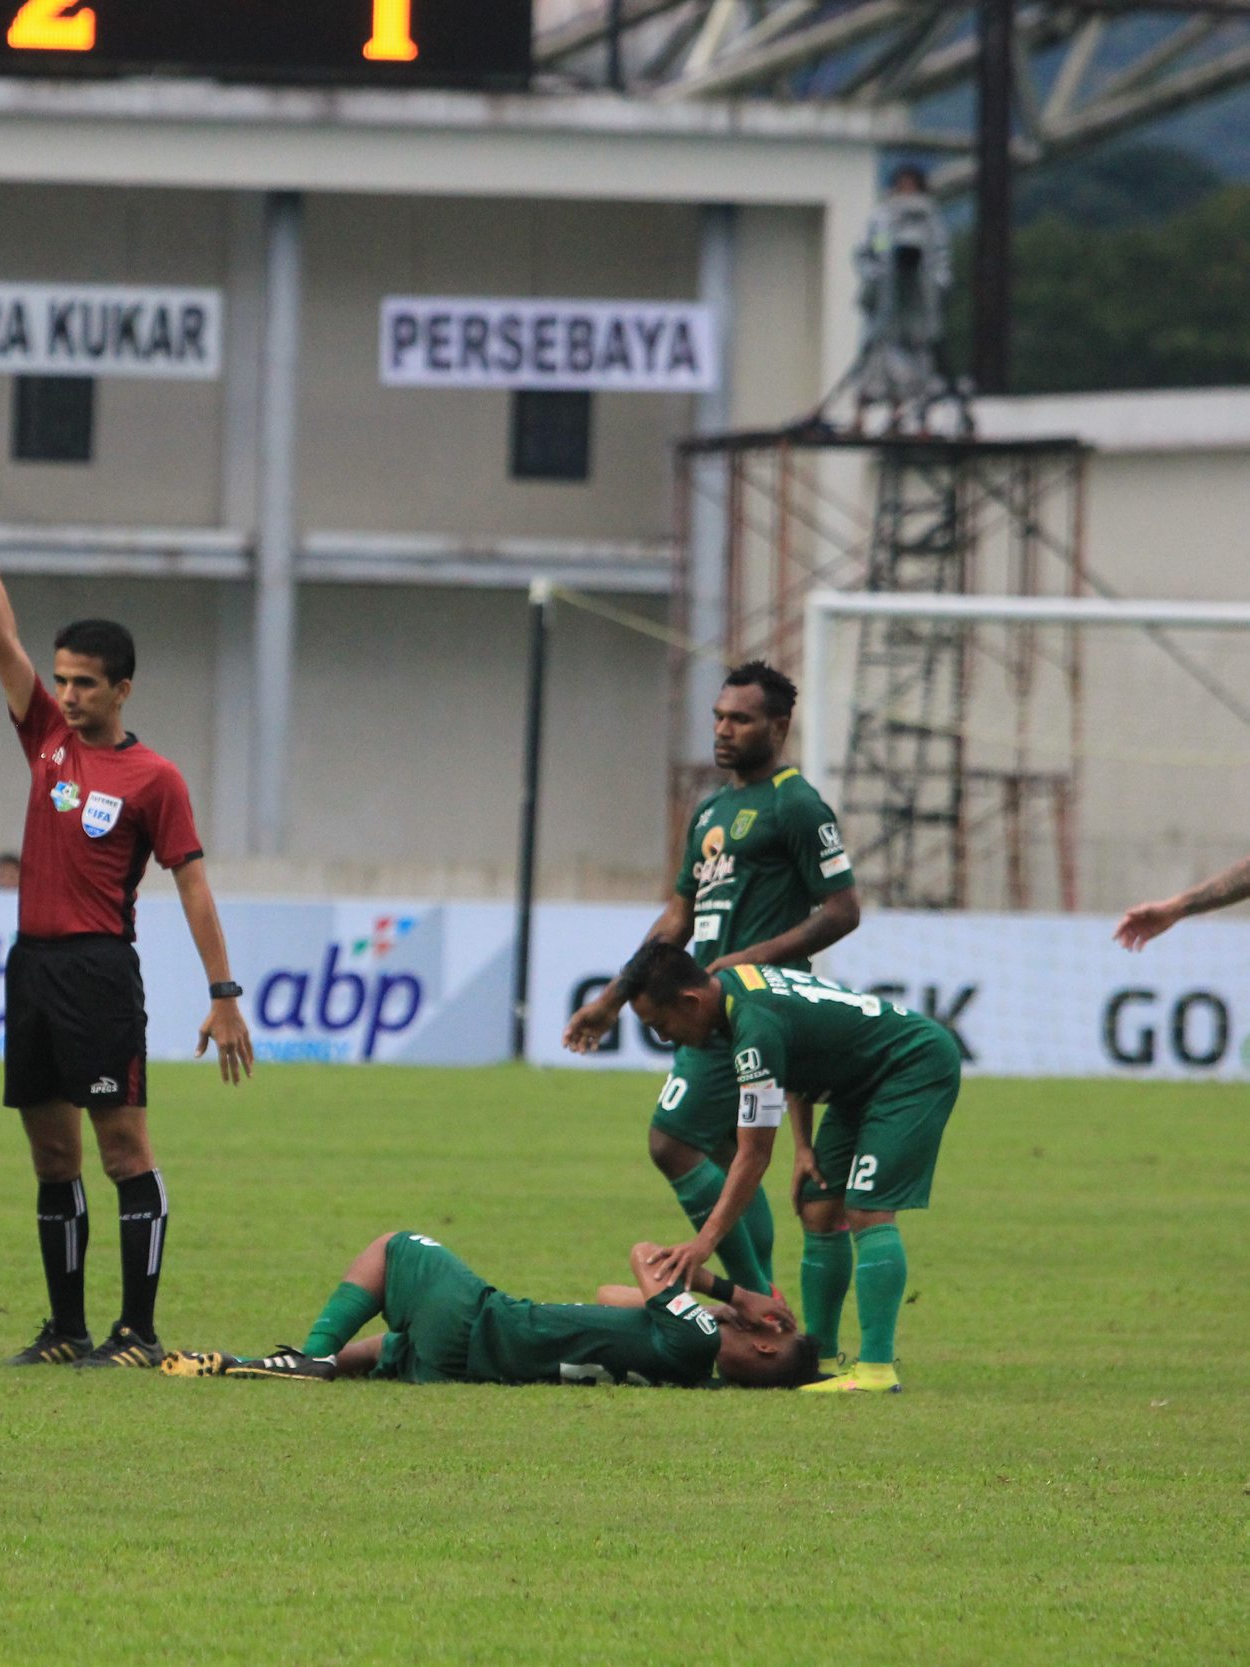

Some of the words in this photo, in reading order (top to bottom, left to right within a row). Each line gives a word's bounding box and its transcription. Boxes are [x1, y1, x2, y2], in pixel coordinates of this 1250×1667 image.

[49, 300, 207, 361] KUKAR
[391, 312, 698, 374] PERSEBAYA
[255, 940, 426, 1062] abp
[1102, 989, 1231, 1066] GO
